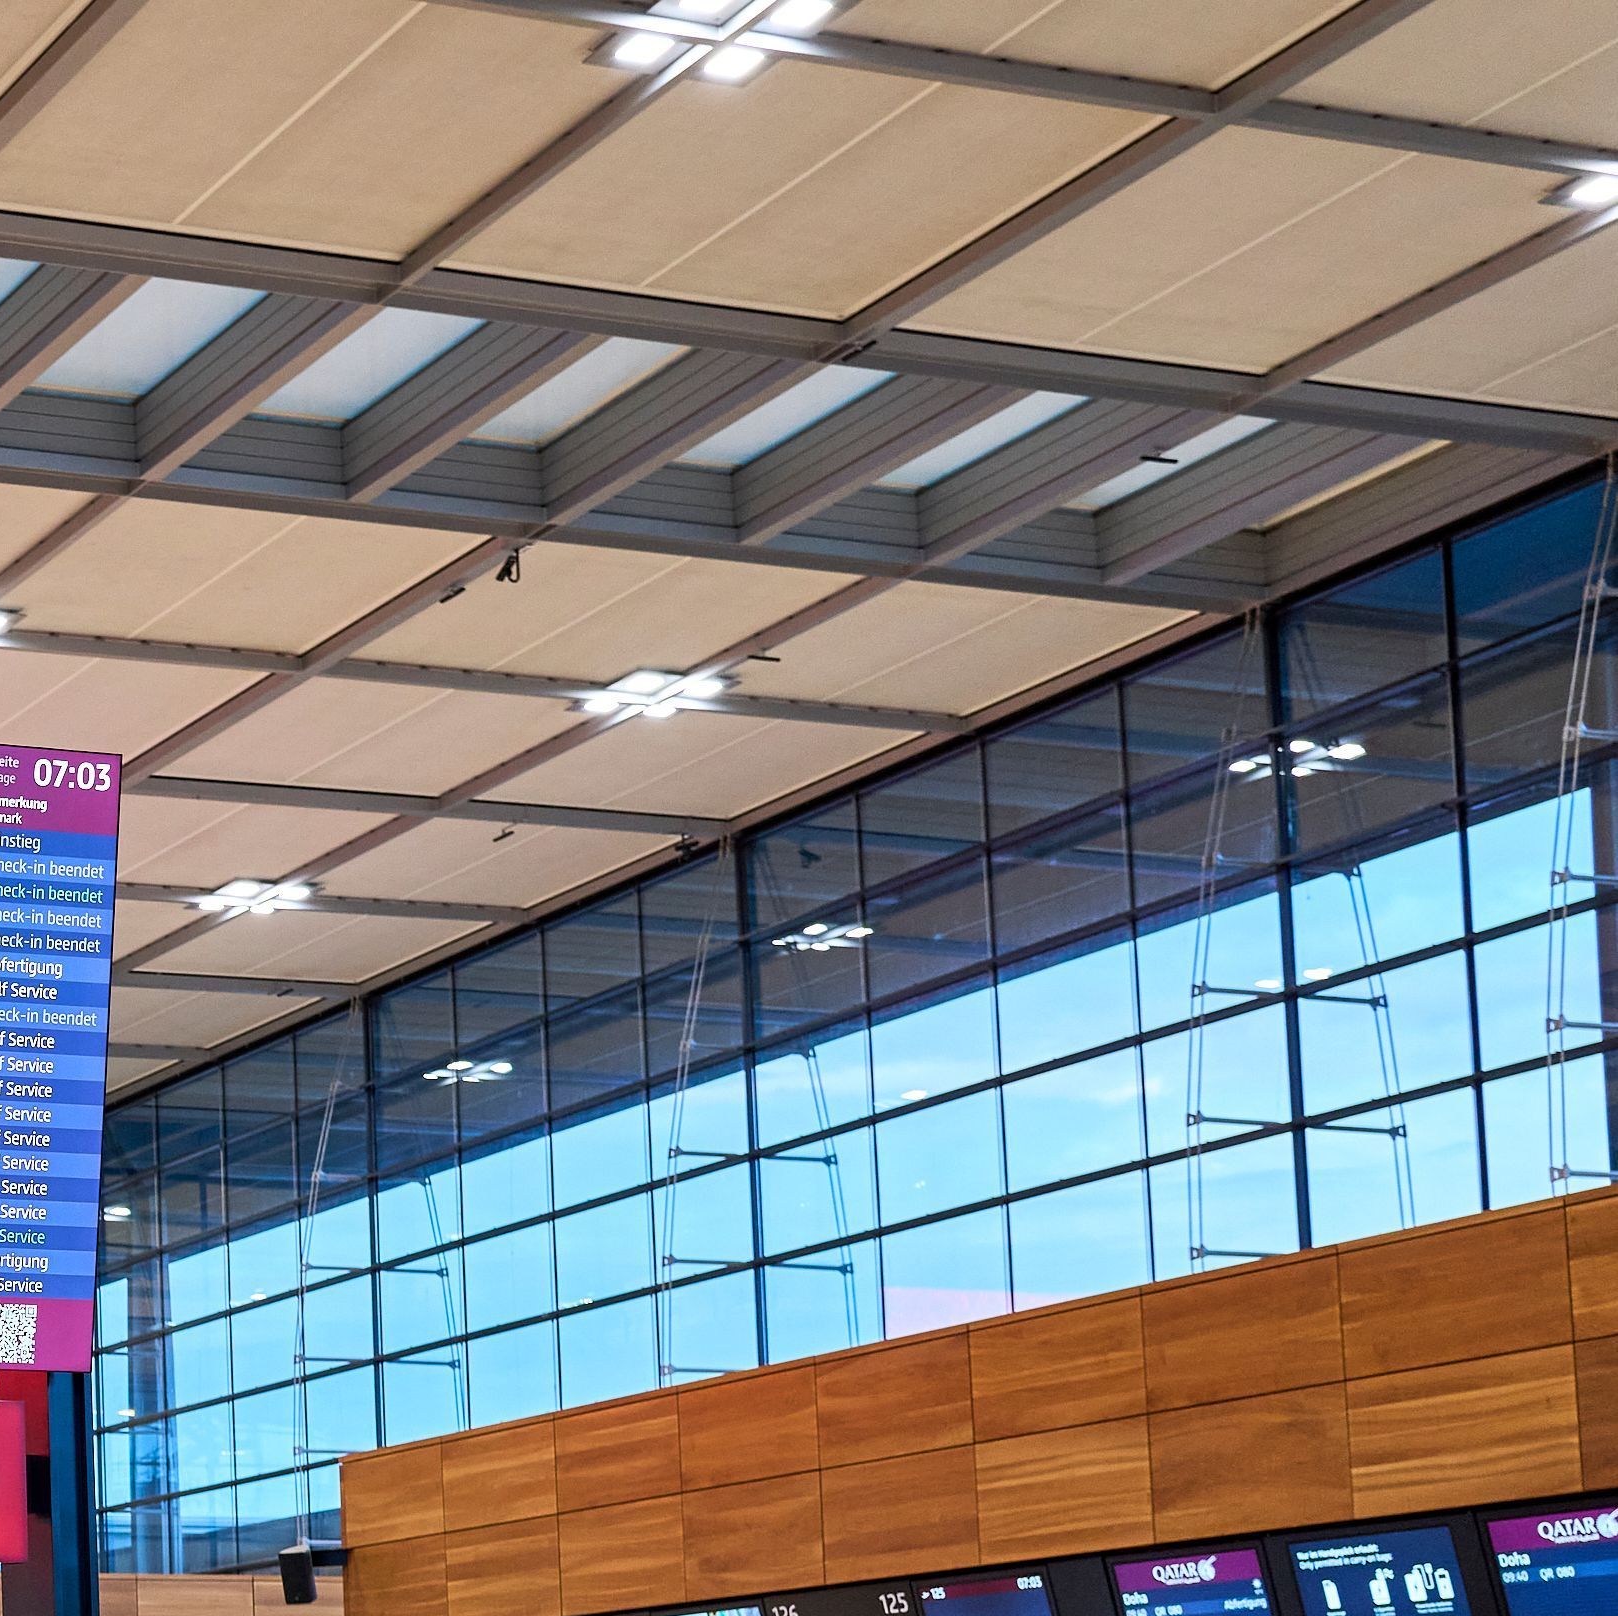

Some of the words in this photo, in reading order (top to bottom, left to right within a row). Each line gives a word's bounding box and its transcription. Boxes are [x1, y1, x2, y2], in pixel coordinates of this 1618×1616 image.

[34, 759, 111, 791] 07:03
[1537, 1516, 1597, 1541] QATAR
[1497, 1551, 1531, 1568] Doha
[1152, 1561, 1198, 1582] QATAR
[879, 1592, 908, 1614] 125
[1122, 1591, 1149, 1606] Doha
